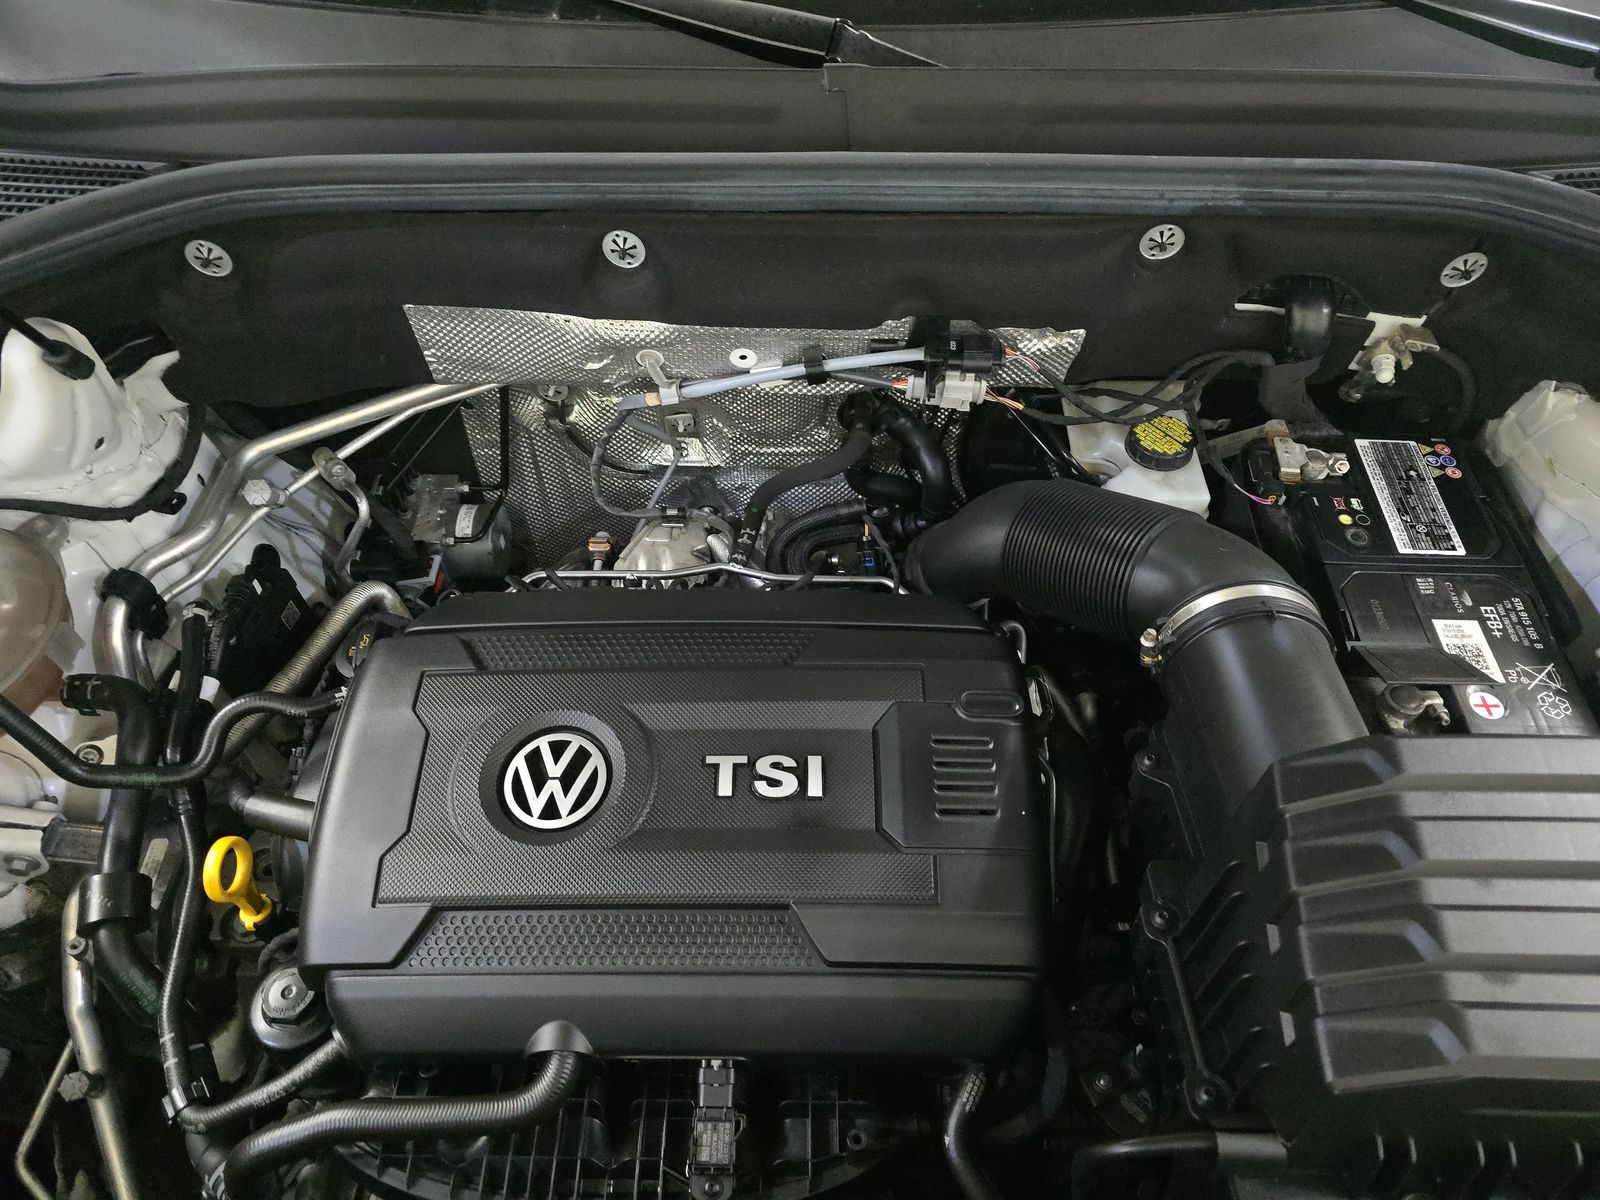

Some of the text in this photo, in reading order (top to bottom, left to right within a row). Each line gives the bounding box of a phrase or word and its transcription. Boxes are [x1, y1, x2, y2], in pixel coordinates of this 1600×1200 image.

[1444, 582, 1464, 613] CLARIOS
[1480, 606, 1503, 639] EFB+
[1518, 611, 1533, 625] 915
[1526, 627, 1540, 640] 105
[1504, 669, 1518, 683] Pb
[503, 732, 607, 830] VW
[704, 753, 824, 801] TSI
